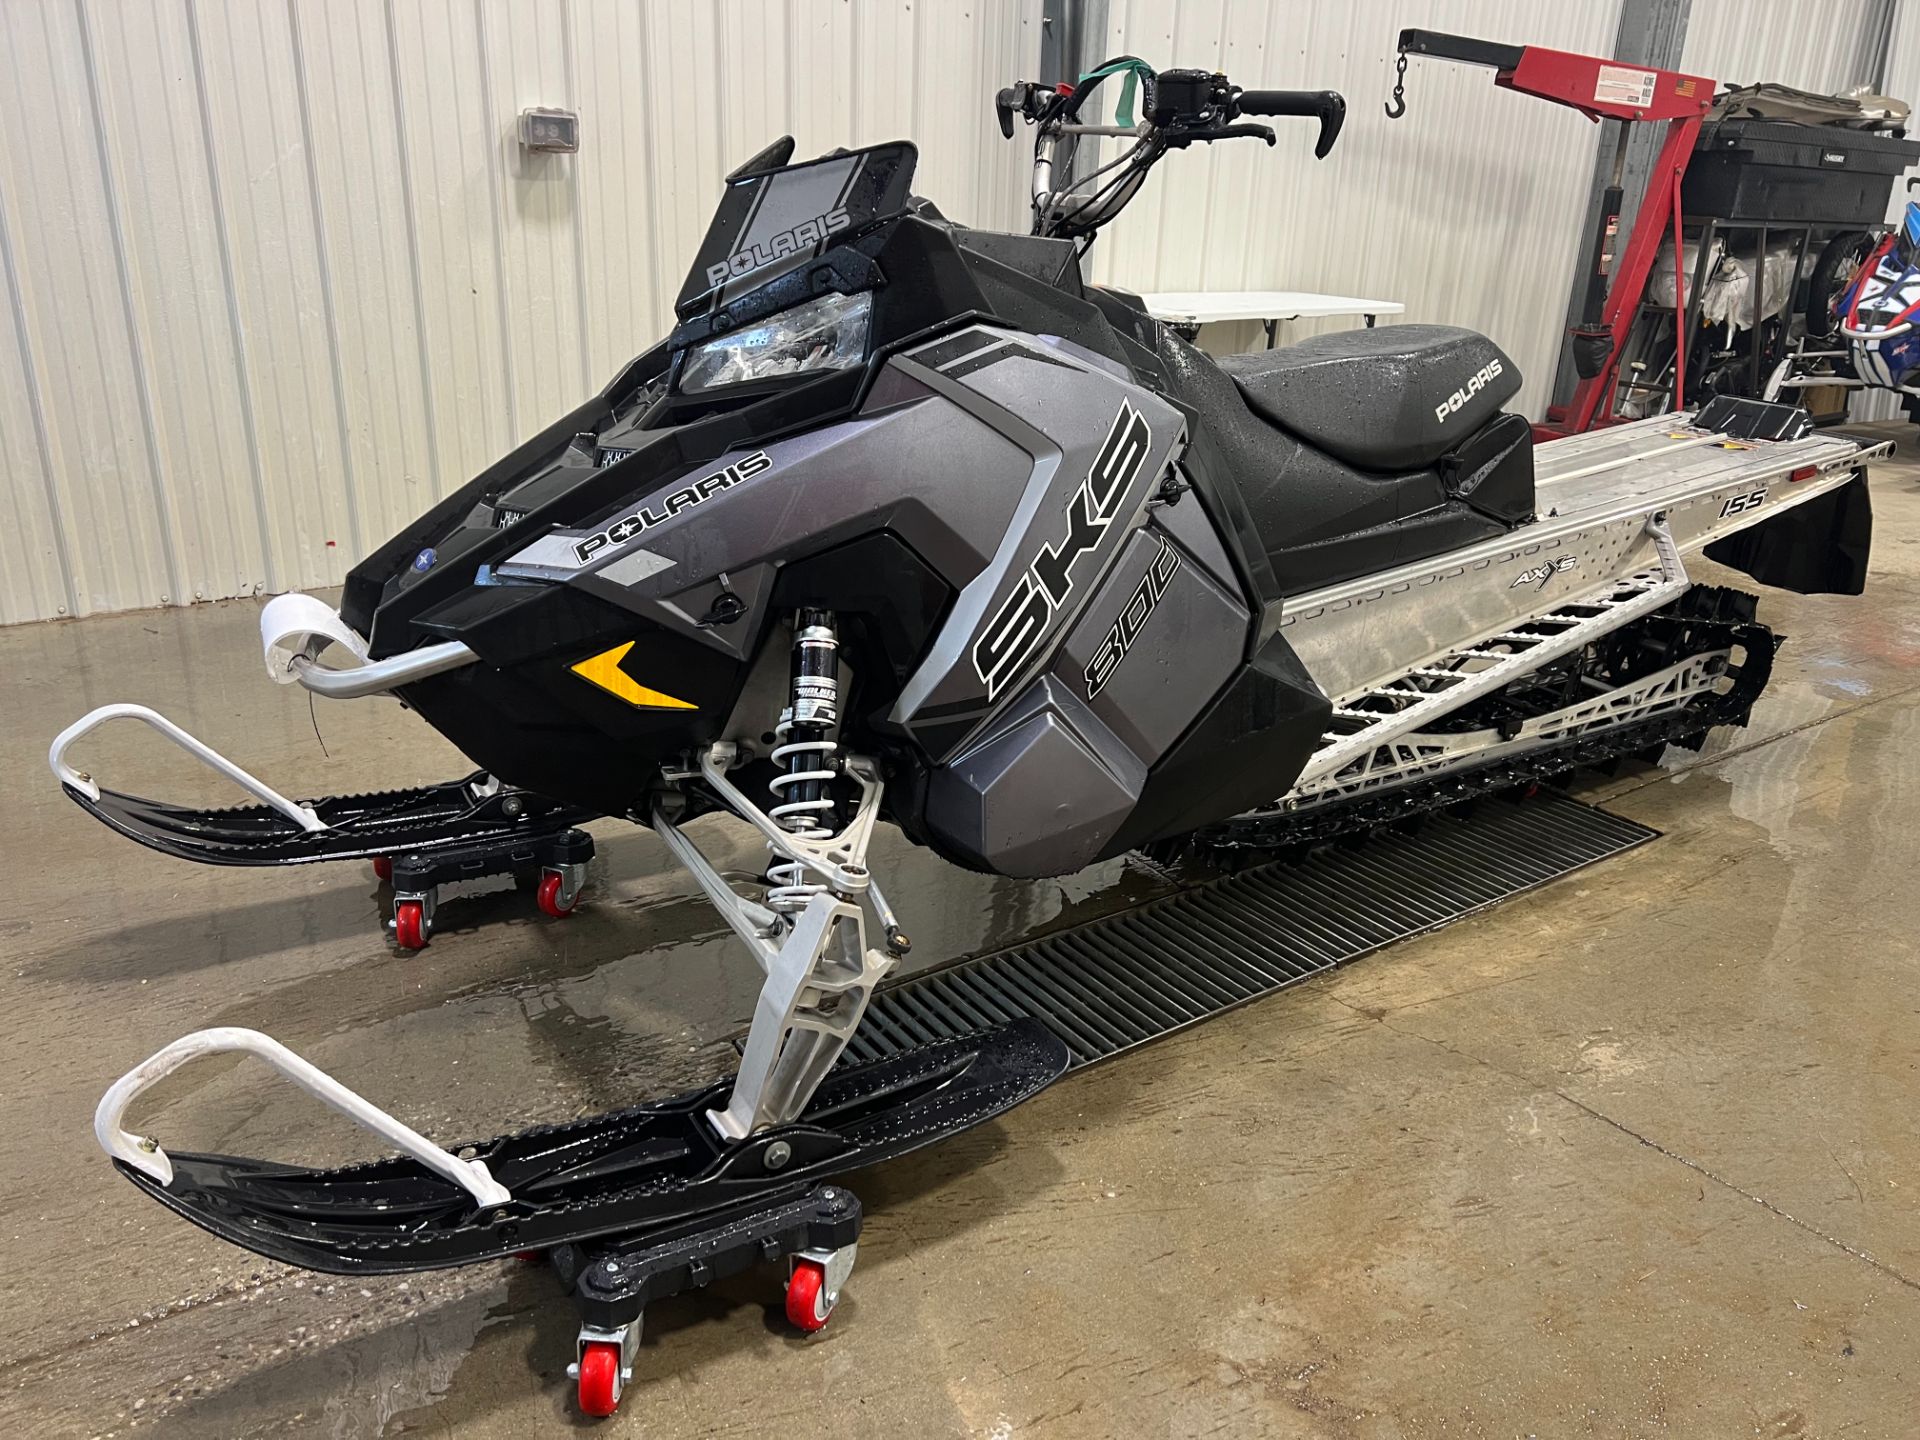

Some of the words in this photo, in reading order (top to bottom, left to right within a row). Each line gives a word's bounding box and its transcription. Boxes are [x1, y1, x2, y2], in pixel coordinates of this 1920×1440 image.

[706, 206, 851, 288] POLARIS
[1435, 358, 1503, 424] POLARIS
[572, 449, 773, 567] POLARIS
[1717, 487, 1769, 520] 155
[972, 396, 1151, 703] SKS
[1509, 554, 1577, 593] AXYS
[1082, 534, 1182, 702] 800
